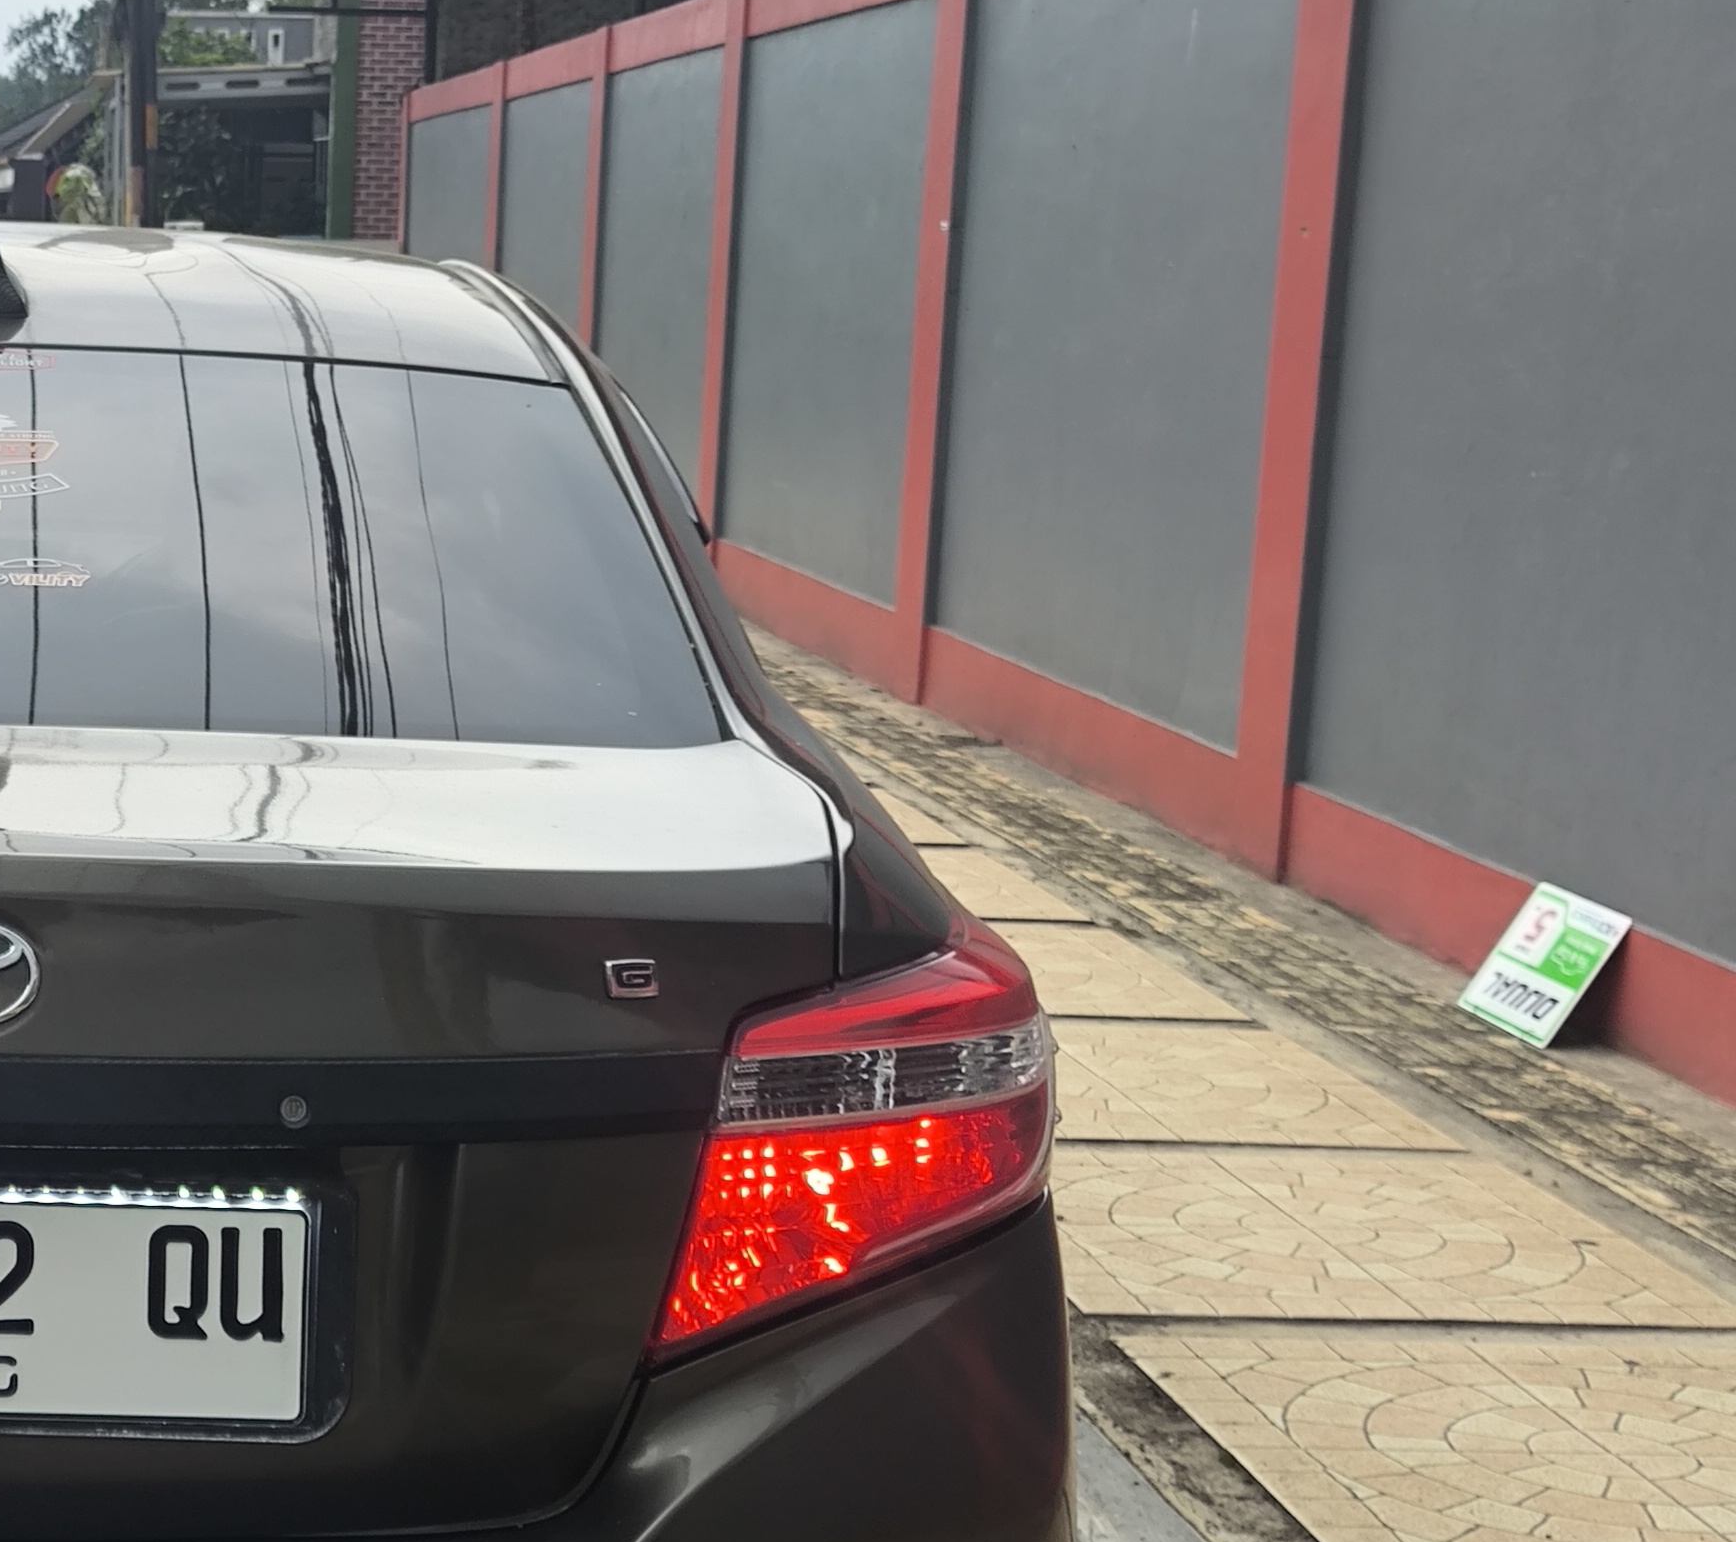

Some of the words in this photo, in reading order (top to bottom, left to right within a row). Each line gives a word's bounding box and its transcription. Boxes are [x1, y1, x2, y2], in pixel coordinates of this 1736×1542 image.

[610, 961, 656, 993] G
[1483, 971, 1561, 1021] DIJUAL
[146, 1223, 286, 1343] QU
